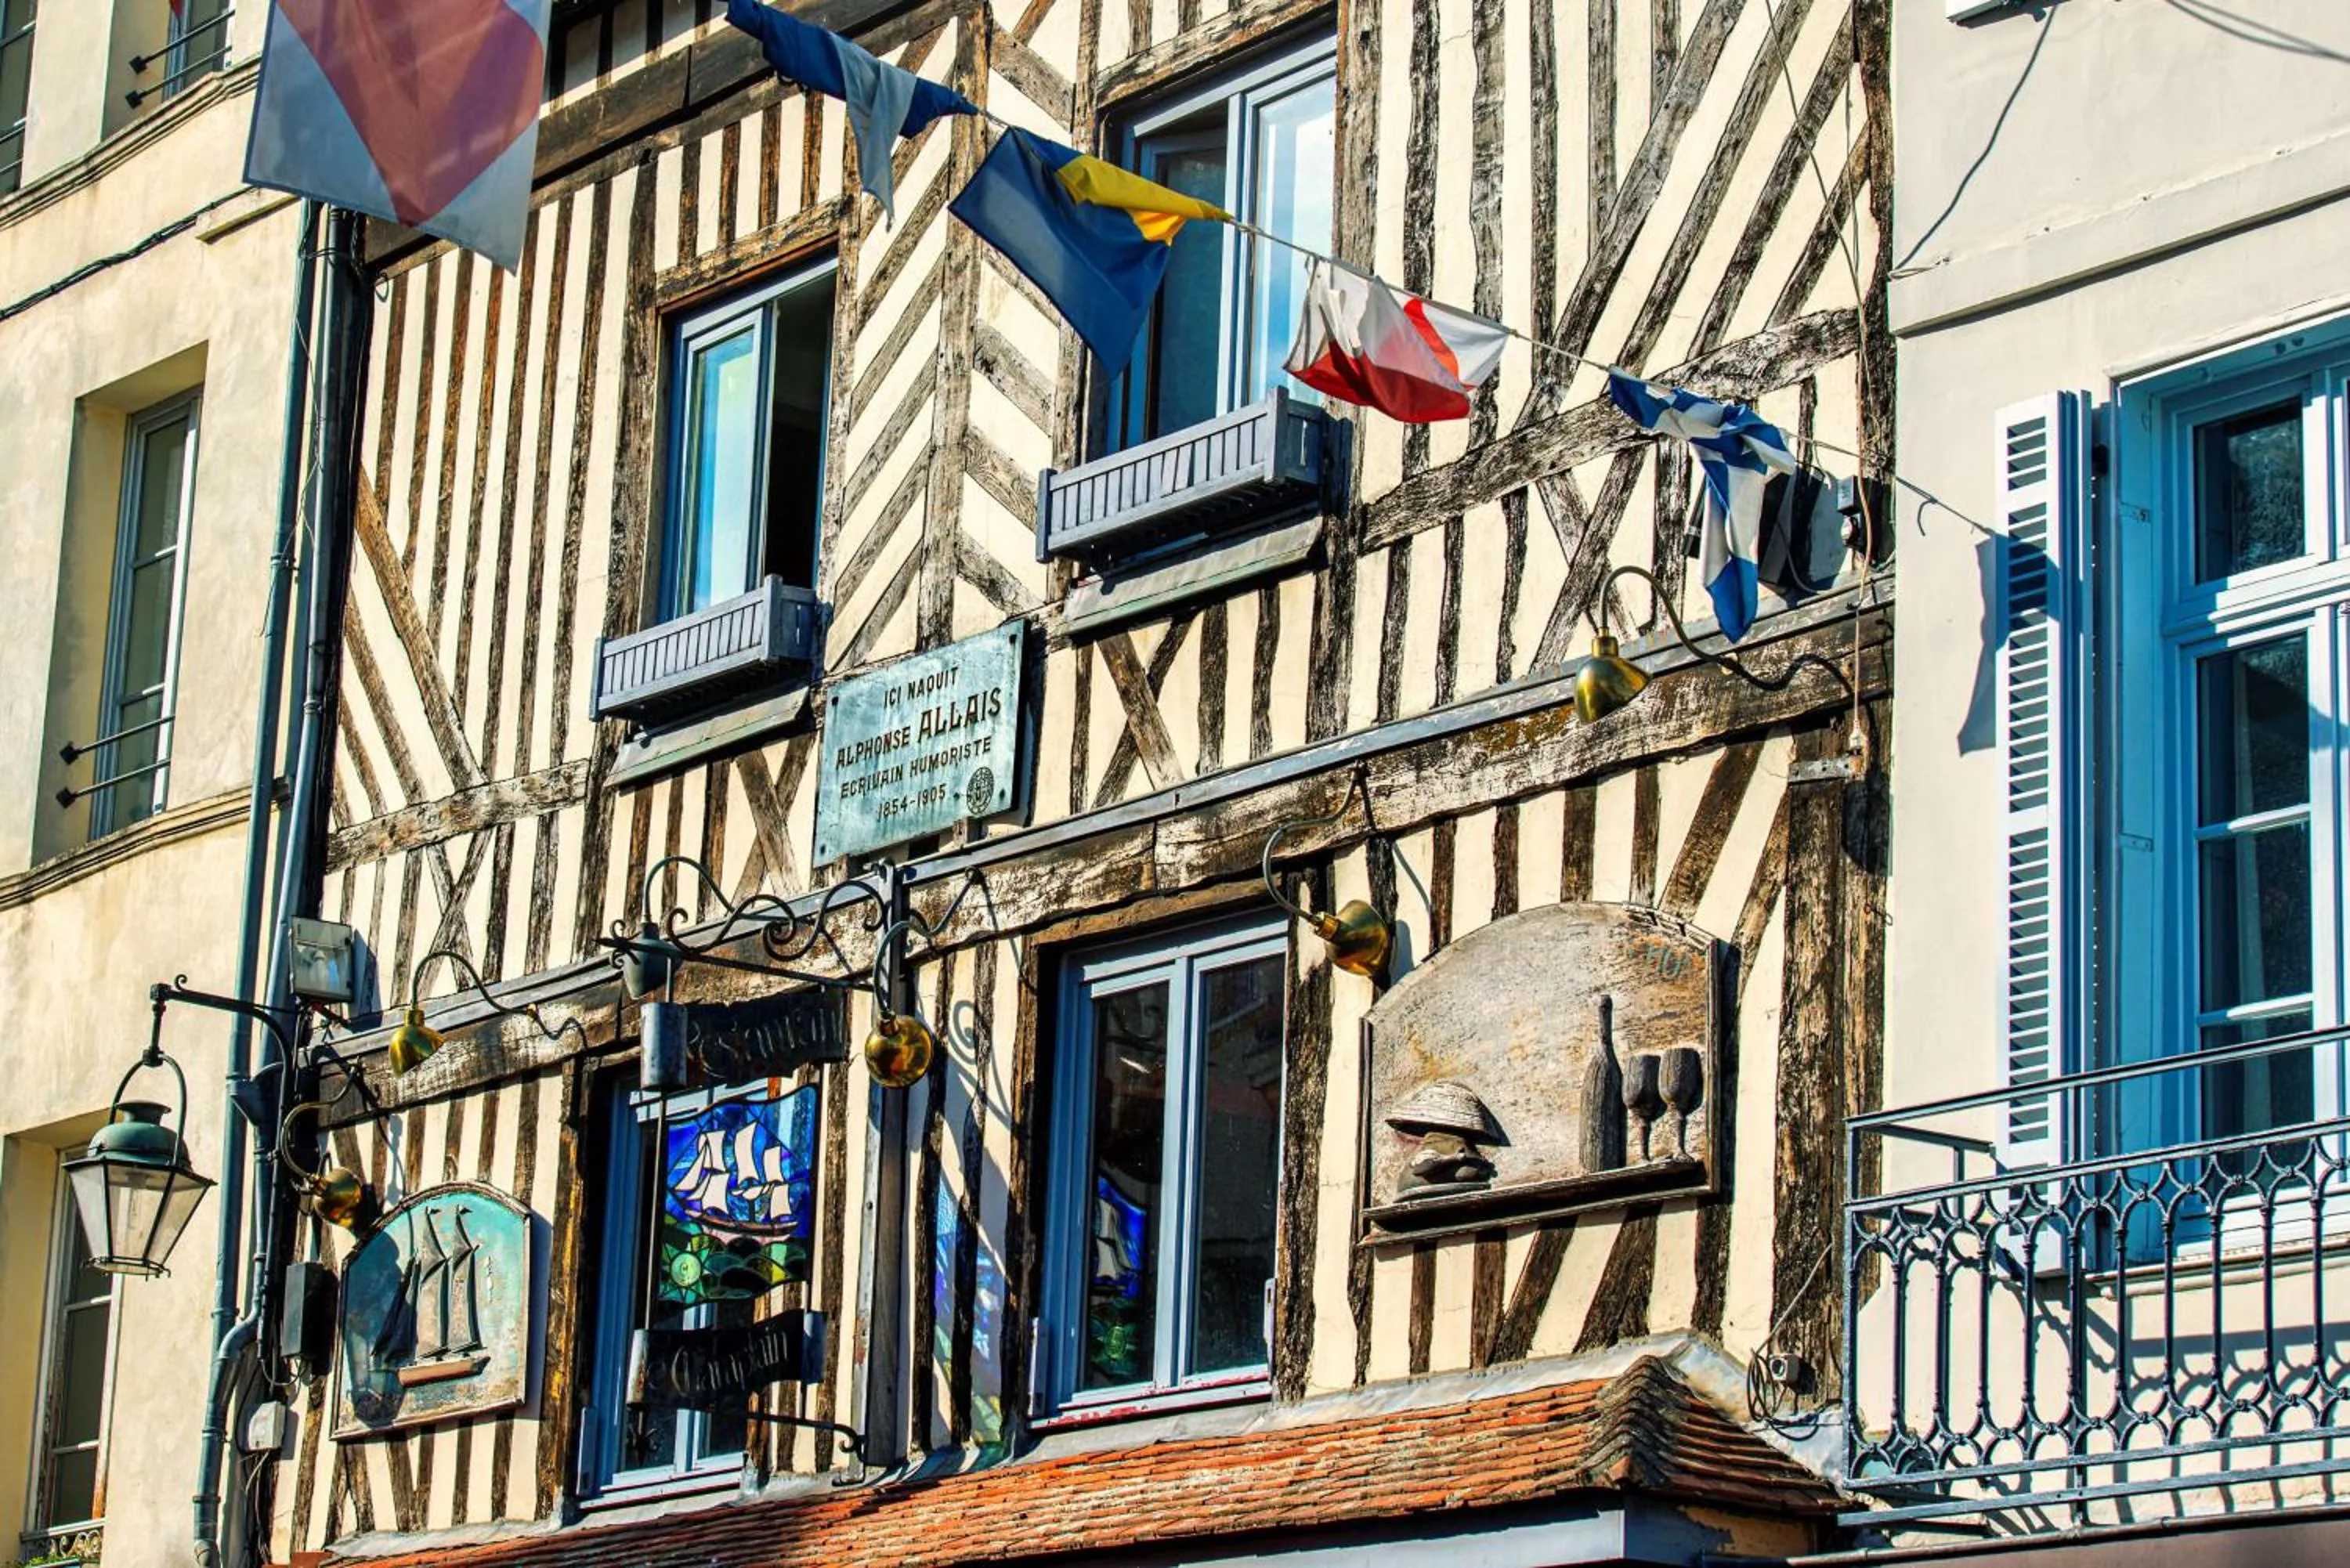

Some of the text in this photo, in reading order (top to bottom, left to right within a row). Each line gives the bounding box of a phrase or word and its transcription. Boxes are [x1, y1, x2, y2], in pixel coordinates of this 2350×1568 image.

[884, 685, 902, 709] ICI
[836, 686, 1002, 771] ALPHONSE ALLAIS
[841, 736, 992, 799] ECRIVAIN HUMORISTE
[877, 783, 947, 822] 1854-1905
